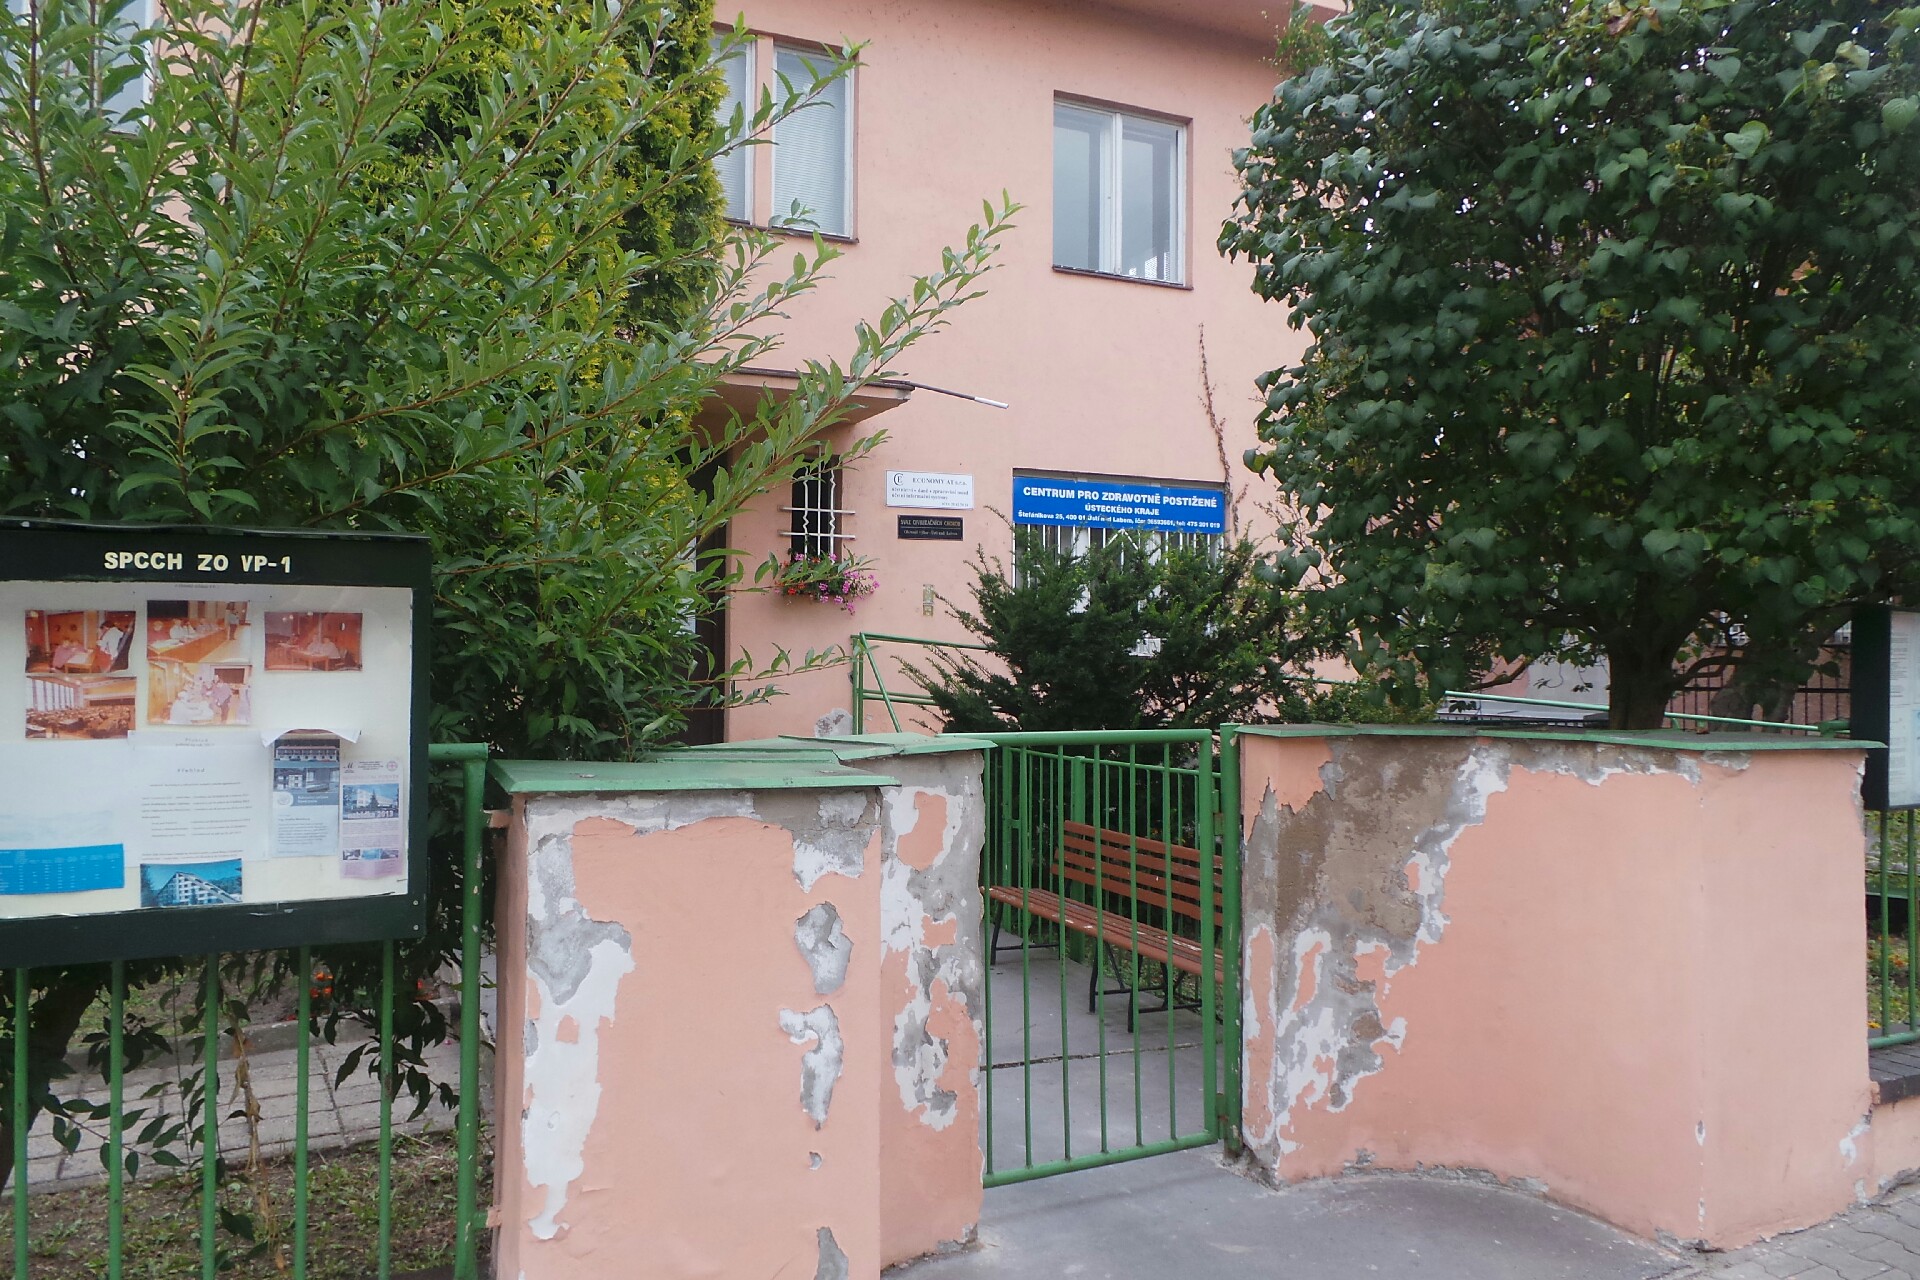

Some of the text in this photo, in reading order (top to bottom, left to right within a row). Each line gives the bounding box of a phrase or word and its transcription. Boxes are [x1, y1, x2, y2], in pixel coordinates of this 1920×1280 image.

[1023, 487, 1217, 508] CENTRUM PRO ZDRAVOTNĚ POSTIŽENÉ
[1084, 502, 1160, 516] ÚSTECKÉHO KRAJE
[1113, 516, 1134, 524] Labem,
[104, 551, 292, 574] SPCCH ZO VP-1
